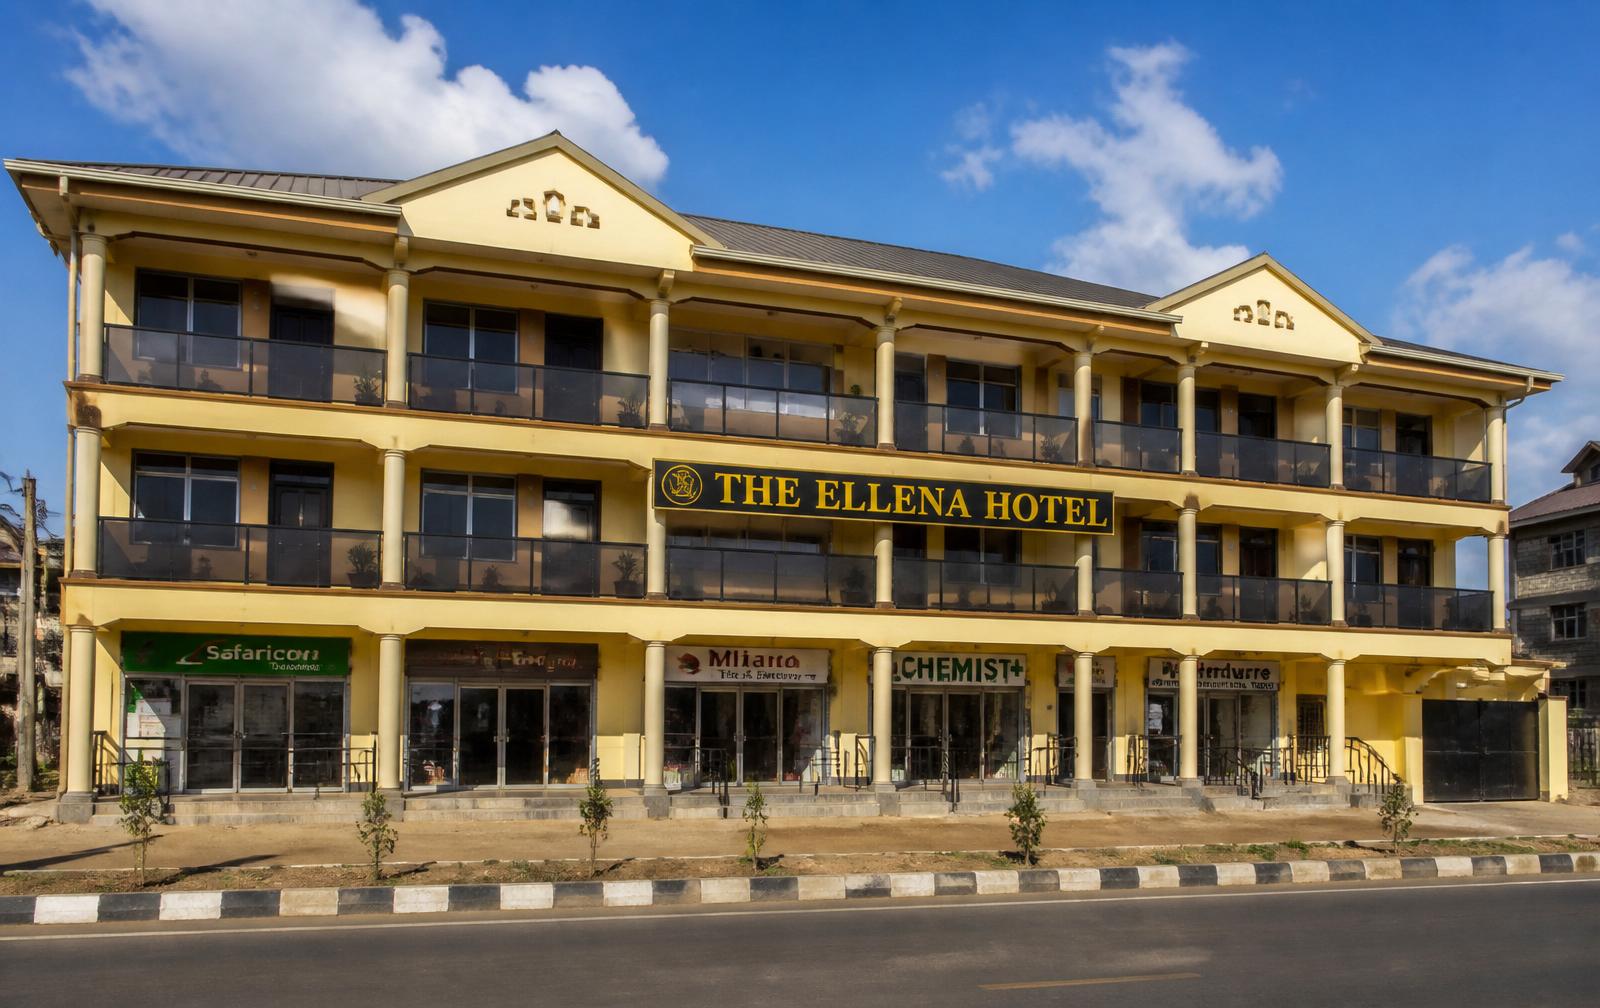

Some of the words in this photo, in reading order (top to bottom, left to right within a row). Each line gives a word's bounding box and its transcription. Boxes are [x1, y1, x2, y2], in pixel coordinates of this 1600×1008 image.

[714, 472, 801, 508] THE
[815, 479, 972, 518] ELLENA
[984, 490, 1108, 527] HOTEL
